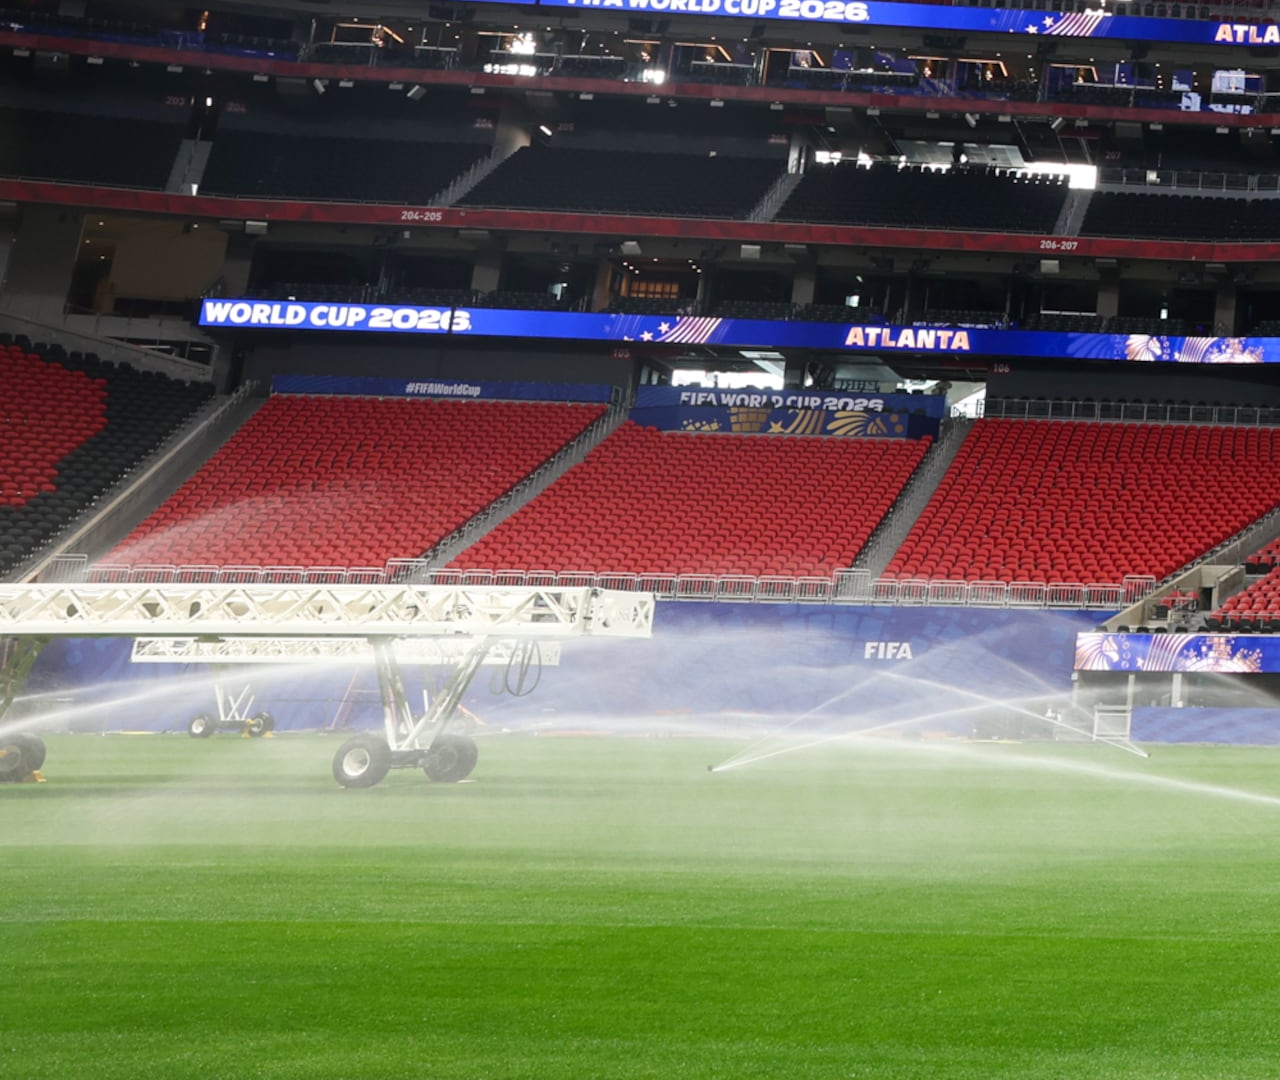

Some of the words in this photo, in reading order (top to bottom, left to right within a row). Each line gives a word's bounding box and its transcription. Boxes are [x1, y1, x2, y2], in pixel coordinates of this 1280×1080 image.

[401, 211, 442, 221] 204-205
[1040, 240, 1079, 250] 206-207
[205, 302, 307, 325] WORLD
[310, 305, 367, 327] CUP
[368, 308, 470, 331] 2026
[845, 325, 970, 350] ATLANTA
[405, 382, 481, 397] #FIFAWorldCup
[680, 392, 717, 406] FIFA
[864, 642, 912, 659] FIFA
